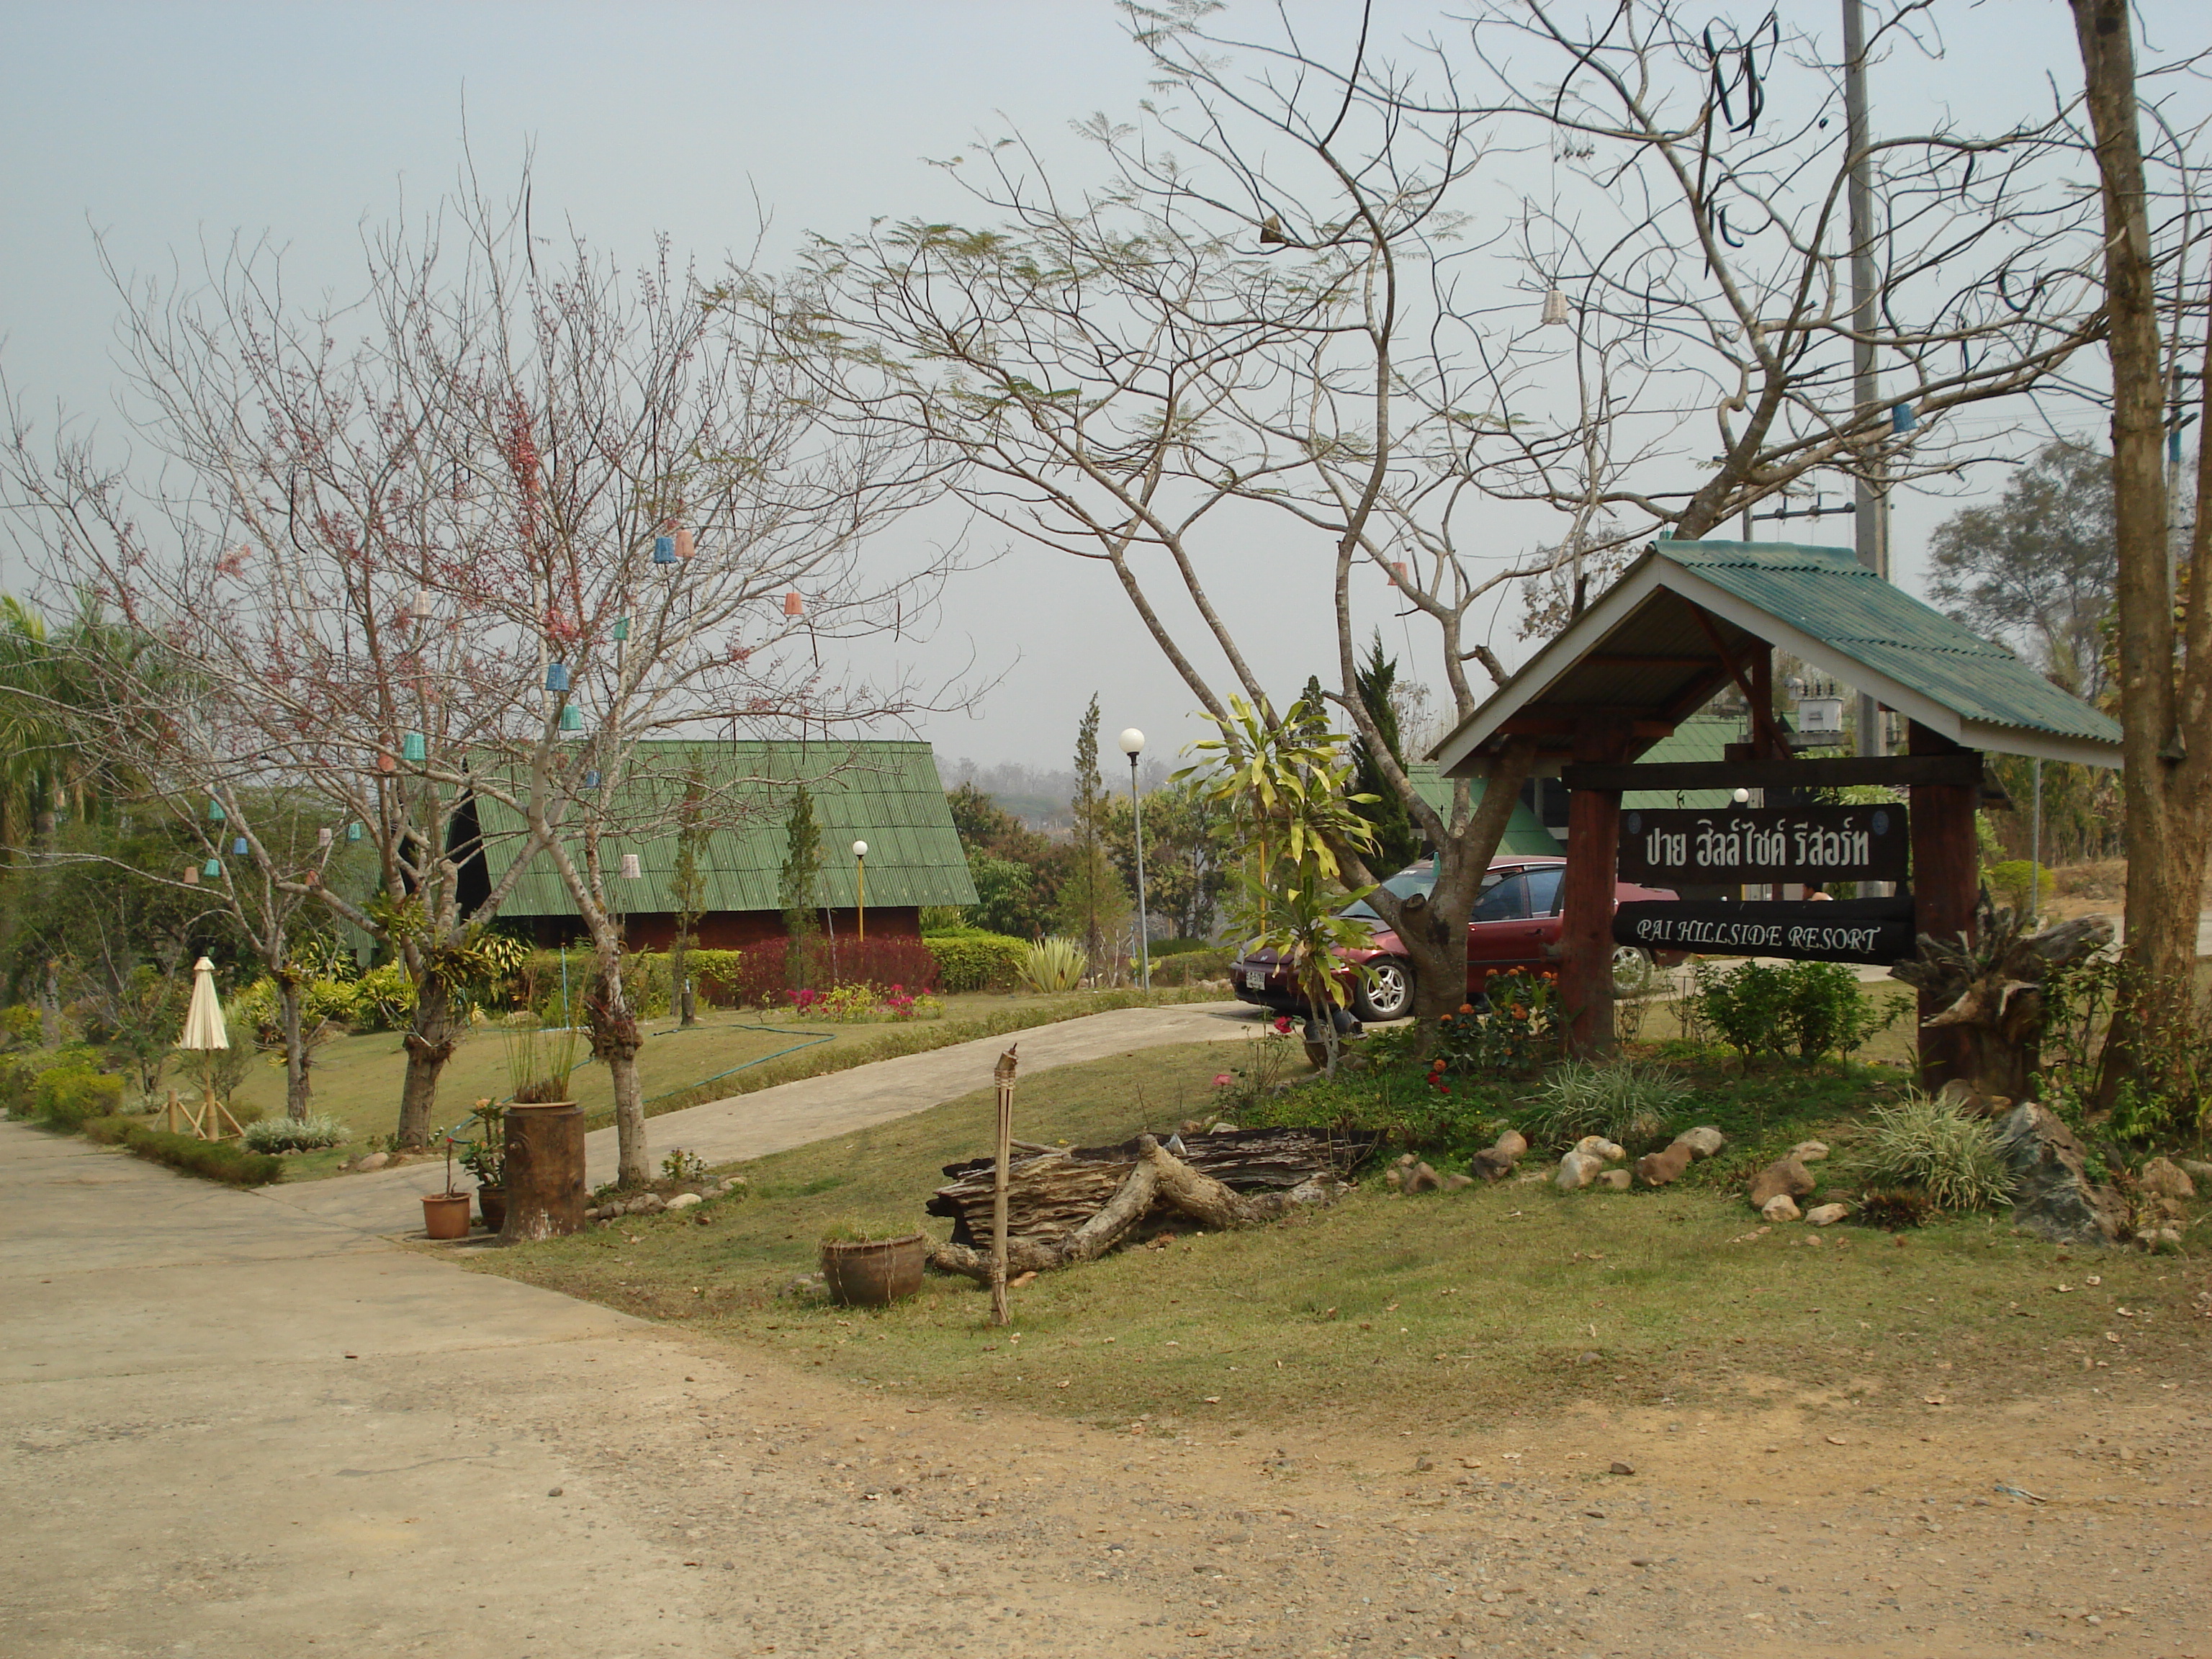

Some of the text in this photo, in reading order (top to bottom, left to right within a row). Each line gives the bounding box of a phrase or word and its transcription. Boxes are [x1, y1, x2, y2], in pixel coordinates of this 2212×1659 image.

[1645, 827, 1686, 866] ปาย
[1637, 919, 1881, 954] PAI HILLSIDE RESORT
